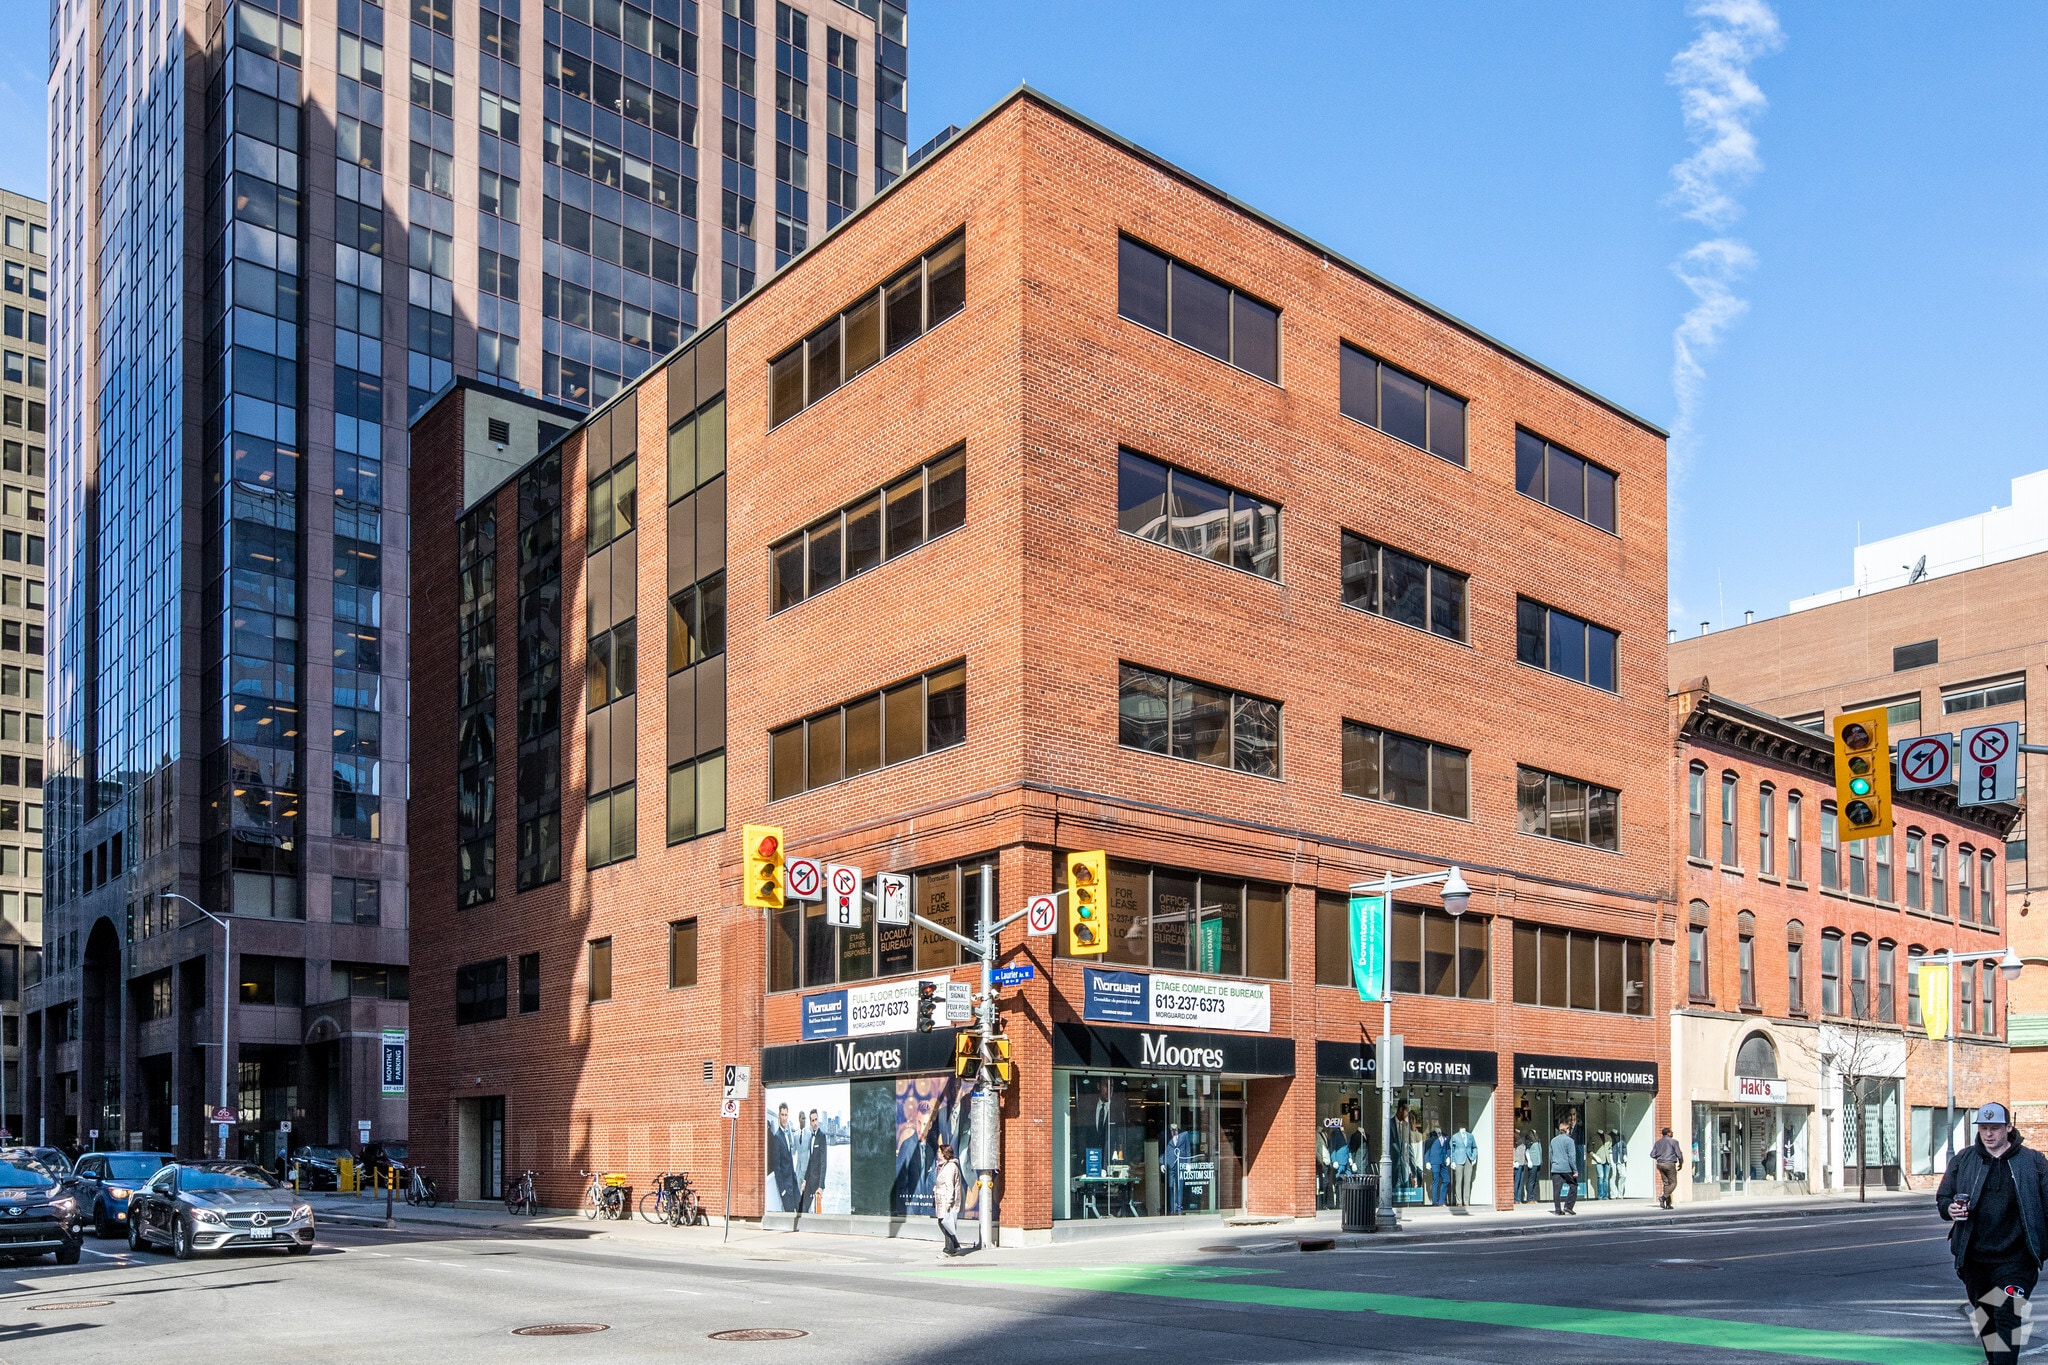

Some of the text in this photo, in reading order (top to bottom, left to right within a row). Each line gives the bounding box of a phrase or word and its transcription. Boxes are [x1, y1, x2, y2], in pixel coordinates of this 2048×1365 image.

[931, 892, 946, 903] FOR
[1116, 888, 1133, 899] FOR
[1159, 894, 1188, 906] OFFICE
[927, 902, 950, 915] LEASE
[1111, 898, 1138, 910] LEASE
[880, 928, 907, 942] LOCAUX
[1154, 923, 1187, 936] LOCAUX
[1358, 904, 1369, 966] Downtown.
[880, 938, 913, 952] BUREAUX
[1001, 971, 1018, 980] Laurier
[1093, 976, 1141, 994] Morguard
[1155, 981, 1264, 1000] ÉTAGE COMPLET DE BUREAUX
[852, 987, 919, 1004] FULL FLOOR OFFICE
[808, 1000, 842, 1014] Morguard
[1155, 994, 1225, 1013] 613-237-6373
[1155, 1011, 1198, 1020] MORGUARD.COM
[853, 1020, 886, 1029] MORGUARD.COM
[835, 1042, 901, 1073] Moores
[1140, 1032, 1224, 1069] Moores
[1418, 1061, 1442, 1074] FOR
[1445, 1063, 1471, 1076] MEN
[1521, 1064, 1654, 1084] VÊTEMENTS POUR HOMMES
[1740, 1079, 1771, 1096] Haki's
[1324, 1117, 1343, 1128] OPEN
[1183, 1170, 1203, 1180] CUSTOM
[1204, 1170, 1215, 1180] SUIT
